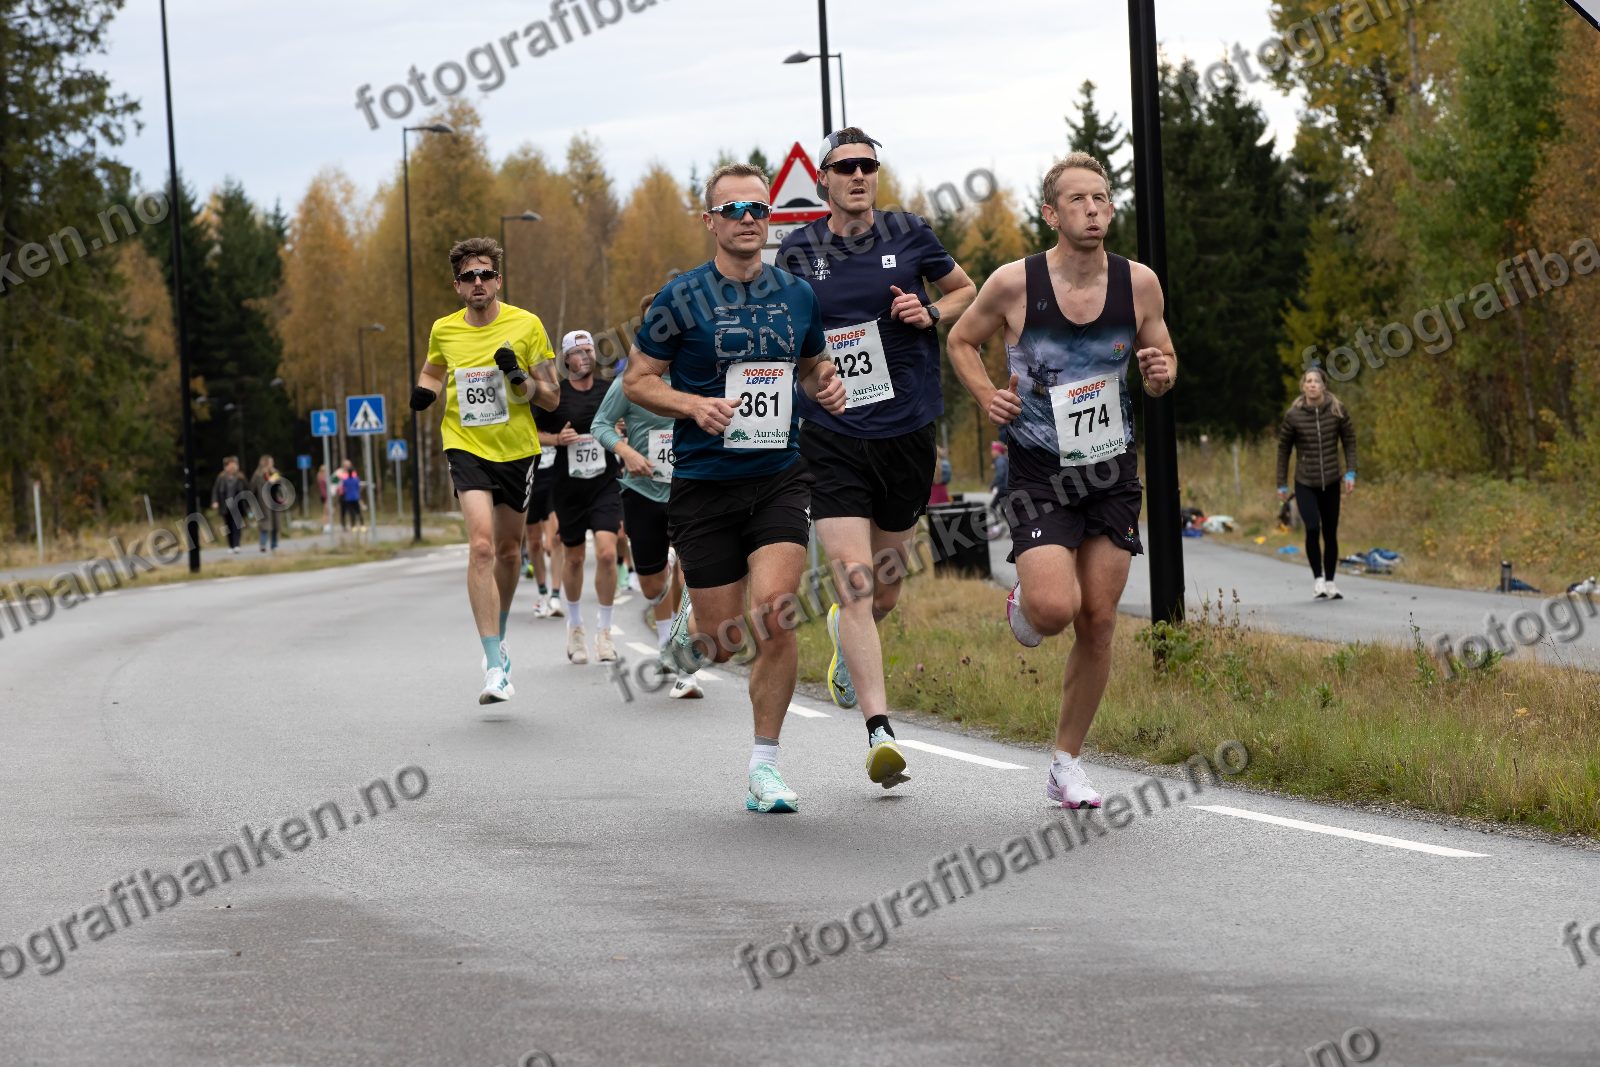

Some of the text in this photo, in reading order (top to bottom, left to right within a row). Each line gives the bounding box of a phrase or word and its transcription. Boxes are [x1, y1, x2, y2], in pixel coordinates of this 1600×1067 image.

[715, 326, 795, 357] ON
[827, 329, 866, 343] NORGES
[832, 338, 860, 350] LØPET
[834, 351, 872, 378] 423
[466, 386, 496, 404] 639
[852, 382, 890, 396] Aurskog
[1067, 380, 1106, 398] NORGES
[1073, 390, 1101, 404] LØPET
[739, 391, 779, 417] 361
[1068, 404, 1110, 437] 774
[753, 428, 789, 439] Aurskog
[1090, 438, 1124, 454] Aurskog
[576, 448, 598, 463] 576
